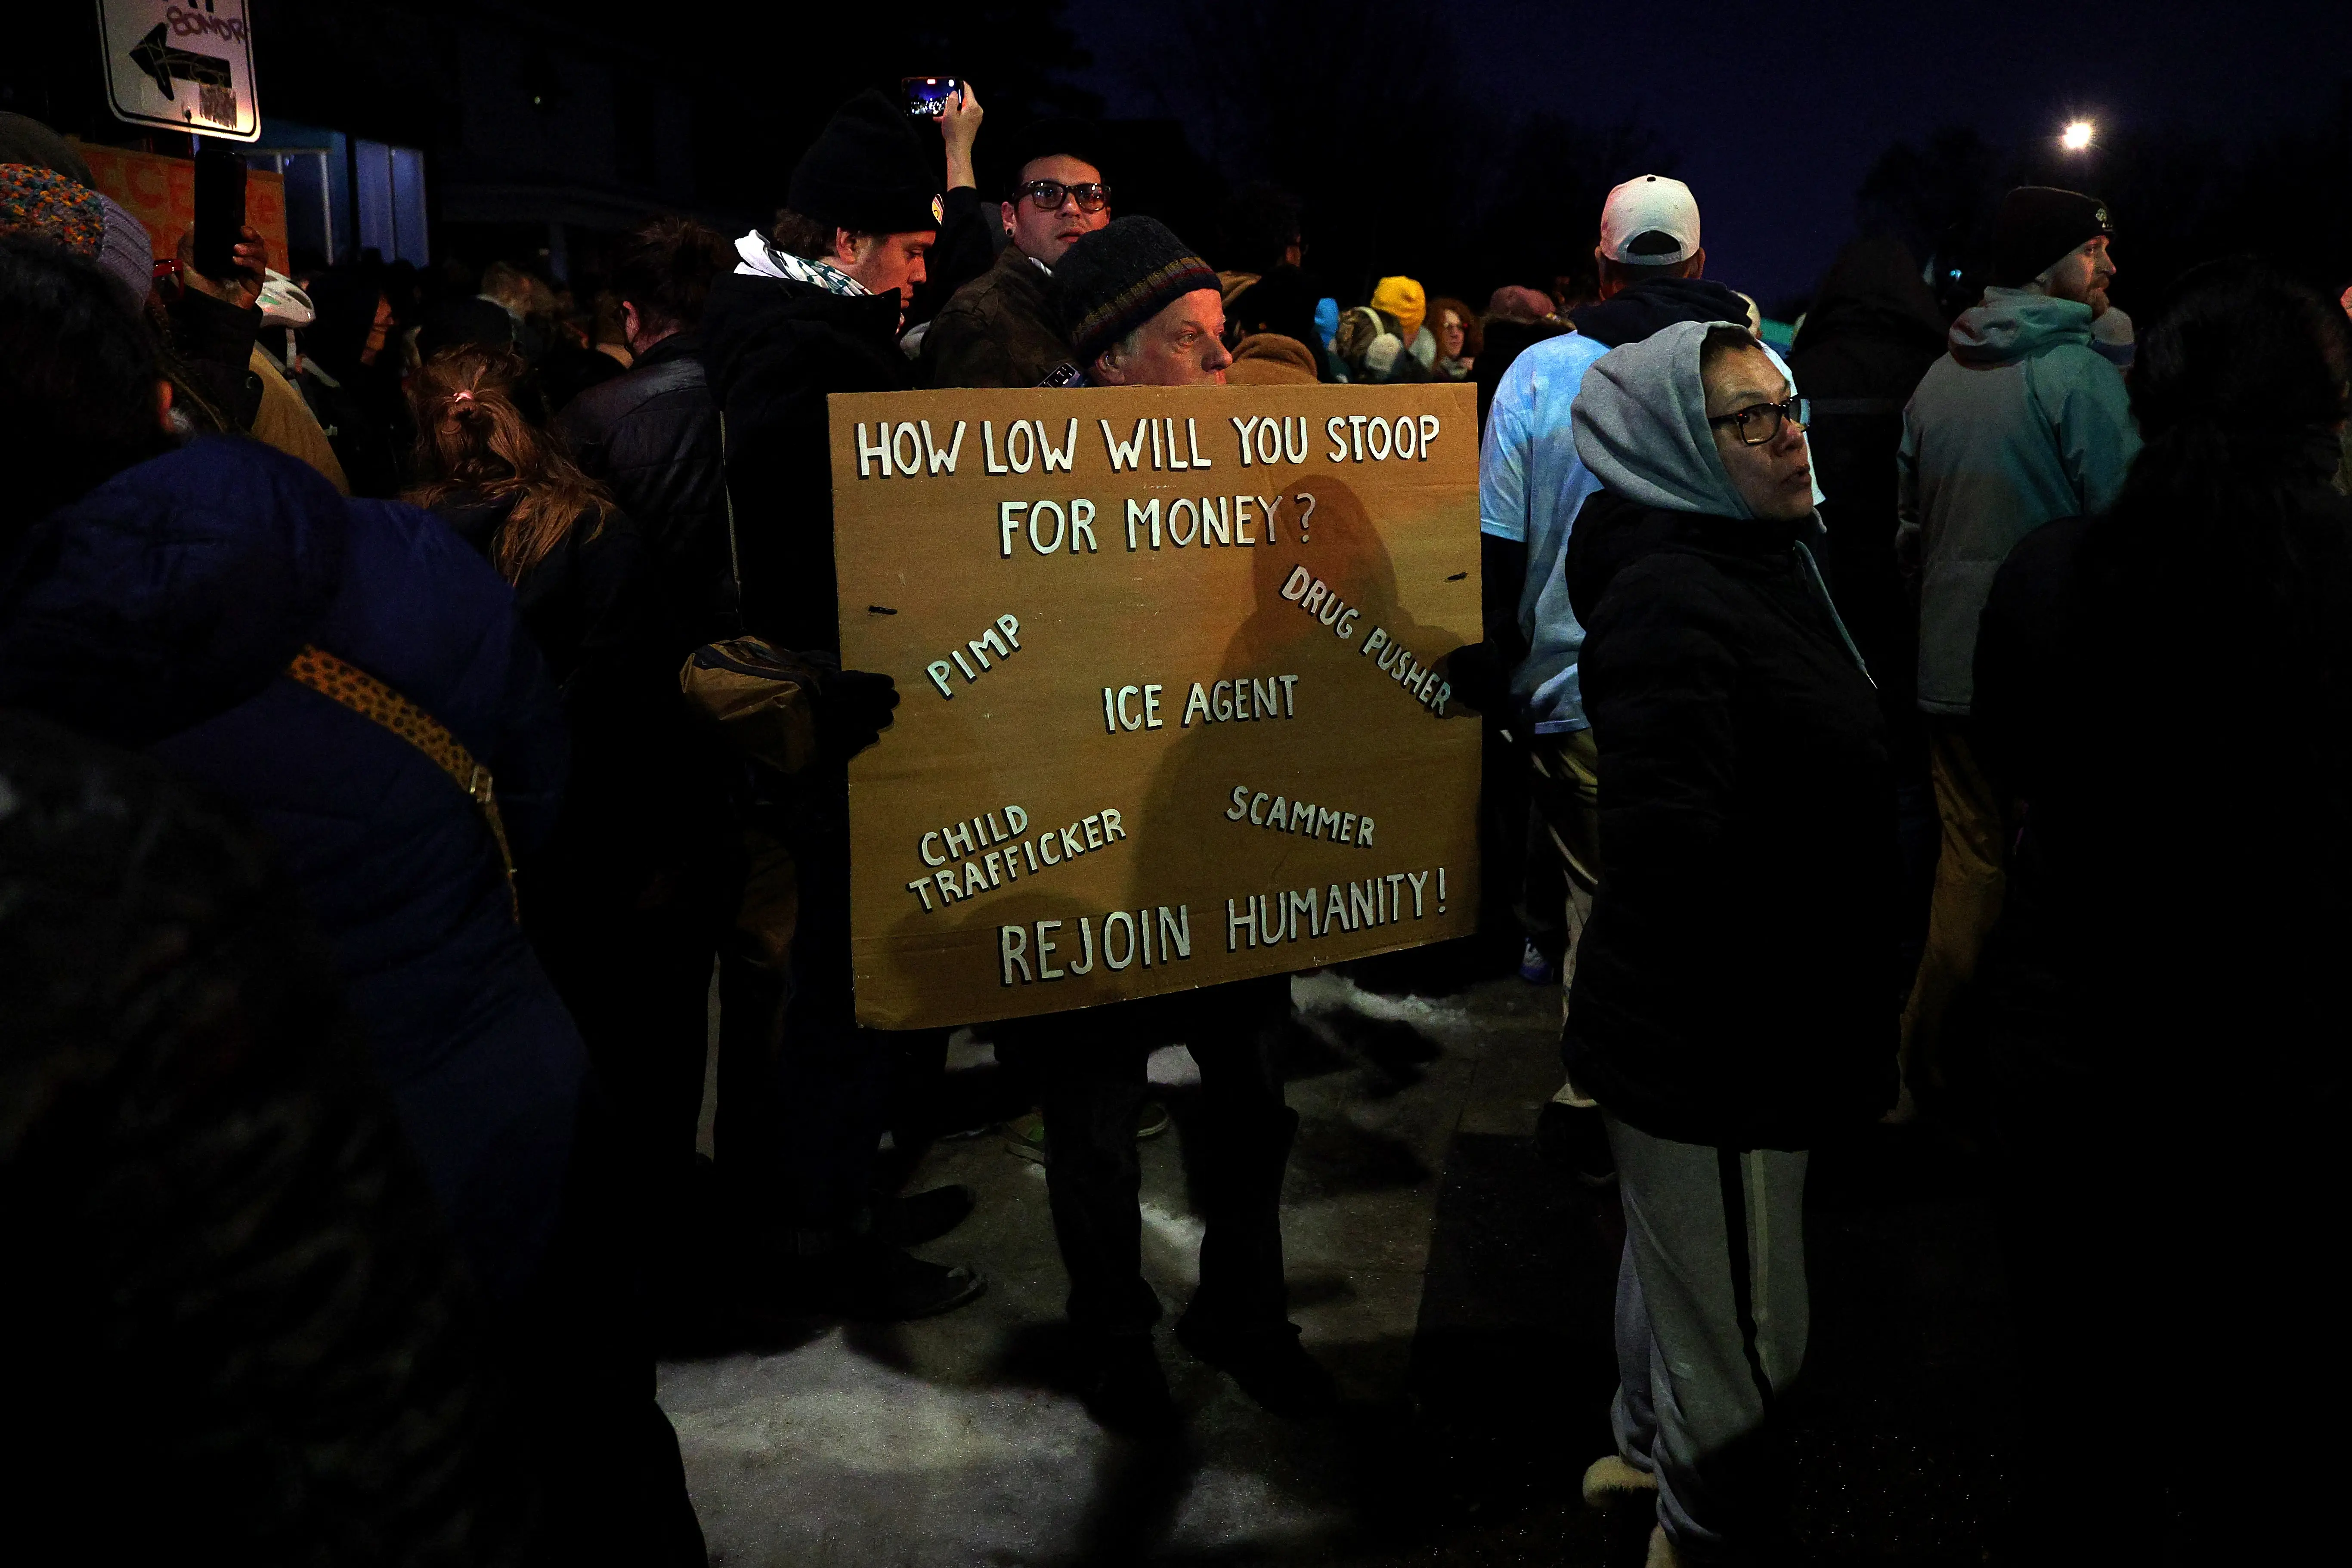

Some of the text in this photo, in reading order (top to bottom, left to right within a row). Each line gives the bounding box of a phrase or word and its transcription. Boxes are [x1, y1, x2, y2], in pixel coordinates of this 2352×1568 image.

[854, 414, 1439, 479] HOW LOW WILL YOU STOOP
[998, 492, 1316, 559] FOR MONEY?
[925, 613, 1019, 700] PIMP
[1279, 563, 1451, 718] DRUG PUSHER
[1102, 674, 1298, 734] ICE AGENT
[919, 804, 1027, 869] CHILD
[1224, 785, 1375, 848] SCAMMER
[906, 808, 1126, 914] TRAFFICKER
[997, 867, 1445, 987] REJOIN HUMANITY!
